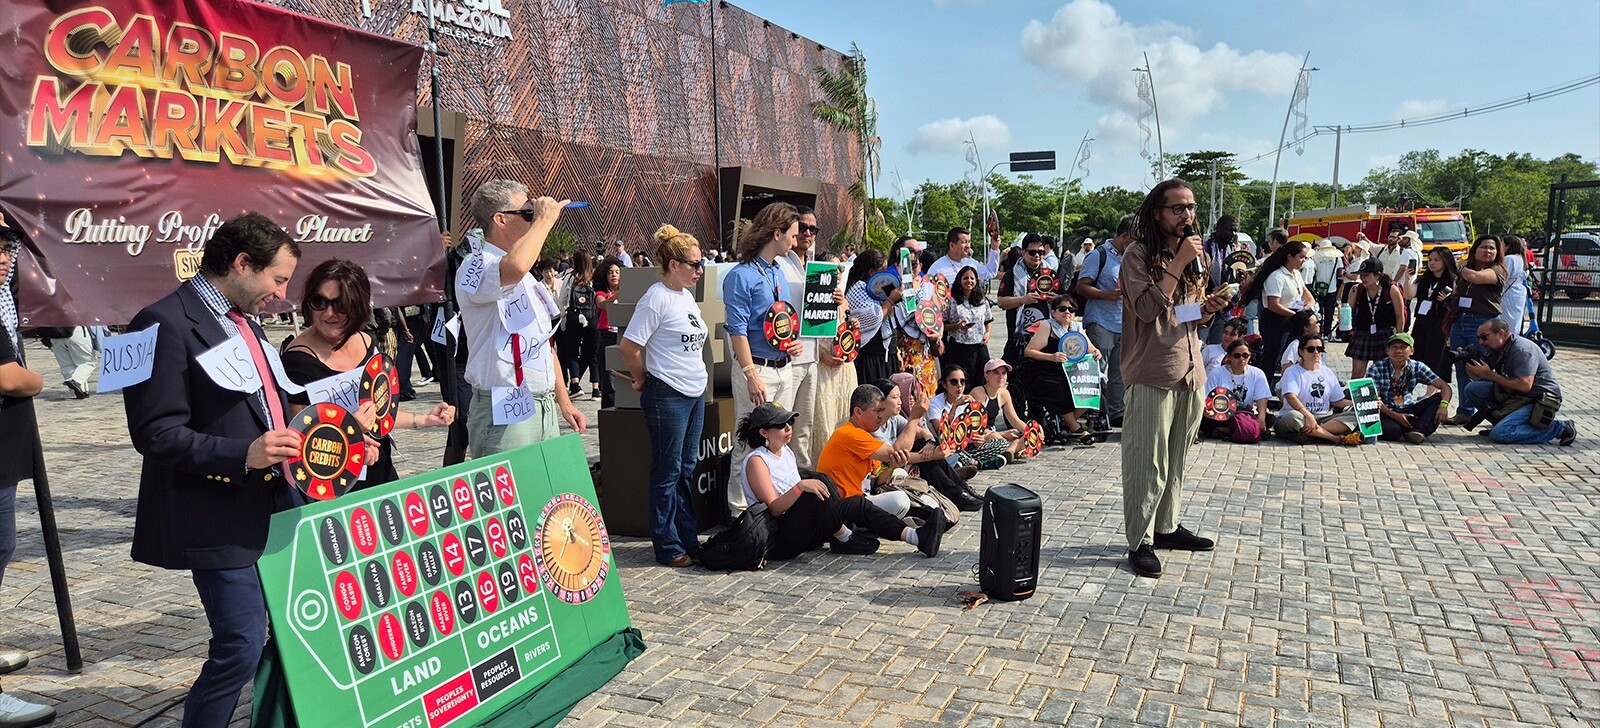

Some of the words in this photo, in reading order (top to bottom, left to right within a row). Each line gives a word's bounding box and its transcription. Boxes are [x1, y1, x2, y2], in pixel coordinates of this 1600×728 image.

[412, 0, 513, 41] AMAZÔNIA
[437, 25, 469, 41] BELÉM
[471, 34, 494, 48] 2025
[45, 6, 359, 122] CARBON
[27, 75, 379, 178] MARKETS
[63, 207, 153, 256] Putting
[293, 213, 374, 243] Planet
[181, 256, 200, 273] SIN
[819, 272, 832, 286] NO
[501, 293, 530, 320] WTO
[803, 309, 838, 320] MARKETS
[433, 319, 446, 339] PE
[102, 335, 154, 376] RUSSIA
[216, 346, 256, 388] US
[1077, 361, 1090, 371] NO
[315, 377, 362, 409] JAPA
[505, 385, 527, 402] SOU
[503, 397, 532, 420] POLE
[311, 437, 343, 455] CARBON
[697, 436, 716, 461] UN
[718, 431, 735, 454] CL
[308, 451, 341, 468] CREDITS
[476, 481, 494, 503] 21
[497, 473, 514, 500] 24
[697, 468, 717, 494] CH
[432, 494, 449, 519] 15
[455, 486, 473, 513] 18
[384, 504, 394, 526] RIVER
[408, 501, 426, 527] 12
[326, 517, 343, 564] SUNDALAND
[354, 518, 367, 547] GUINEA
[360, 514, 374, 547] FORESTS
[390, 525, 399, 541] NILE
[489, 523, 506, 553] 20
[508, 516, 525, 543] 23
[445, 542, 462, 567] 14
[467, 536, 484, 558] 17
[402, 562, 413, 583] RIVER
[421, 551, 433, 578] DANUM
[427, 550, 438, 576] VALLEY
[520, 559, 537, 587] 22
[347, 582, 358, 606] BASIN
[370, 562, 386, 606] HIMALAYAS
[480, 580, 496, 605] 16
[500, 571, 517, 595] 19
[339, 582, 351, 611] CONGO
[458, 590, 474, 614] 13
[415, 612, 425, 633] RIVER
[440, 601, 450, 621] RIVER
[383, 614, 399, 658] SUNDERBANS
[408, 609, 421, 641] AMAZON
[477, 605, 539, 649] OCEANS
[352, 633, 366, 667] AMAZON
[359, 634, 372, 662] FOREST
[524, 641, 551, 663] RIVERS
[390, 656, 442, 696] LAND
[480, 665, 515, 690] RESOURCES
[483, 660, 509, 680] PEOPLES
[429, 689, 474, 720] SOVEREIGNTY
[435, 685, 465, 706] PEOPLES
